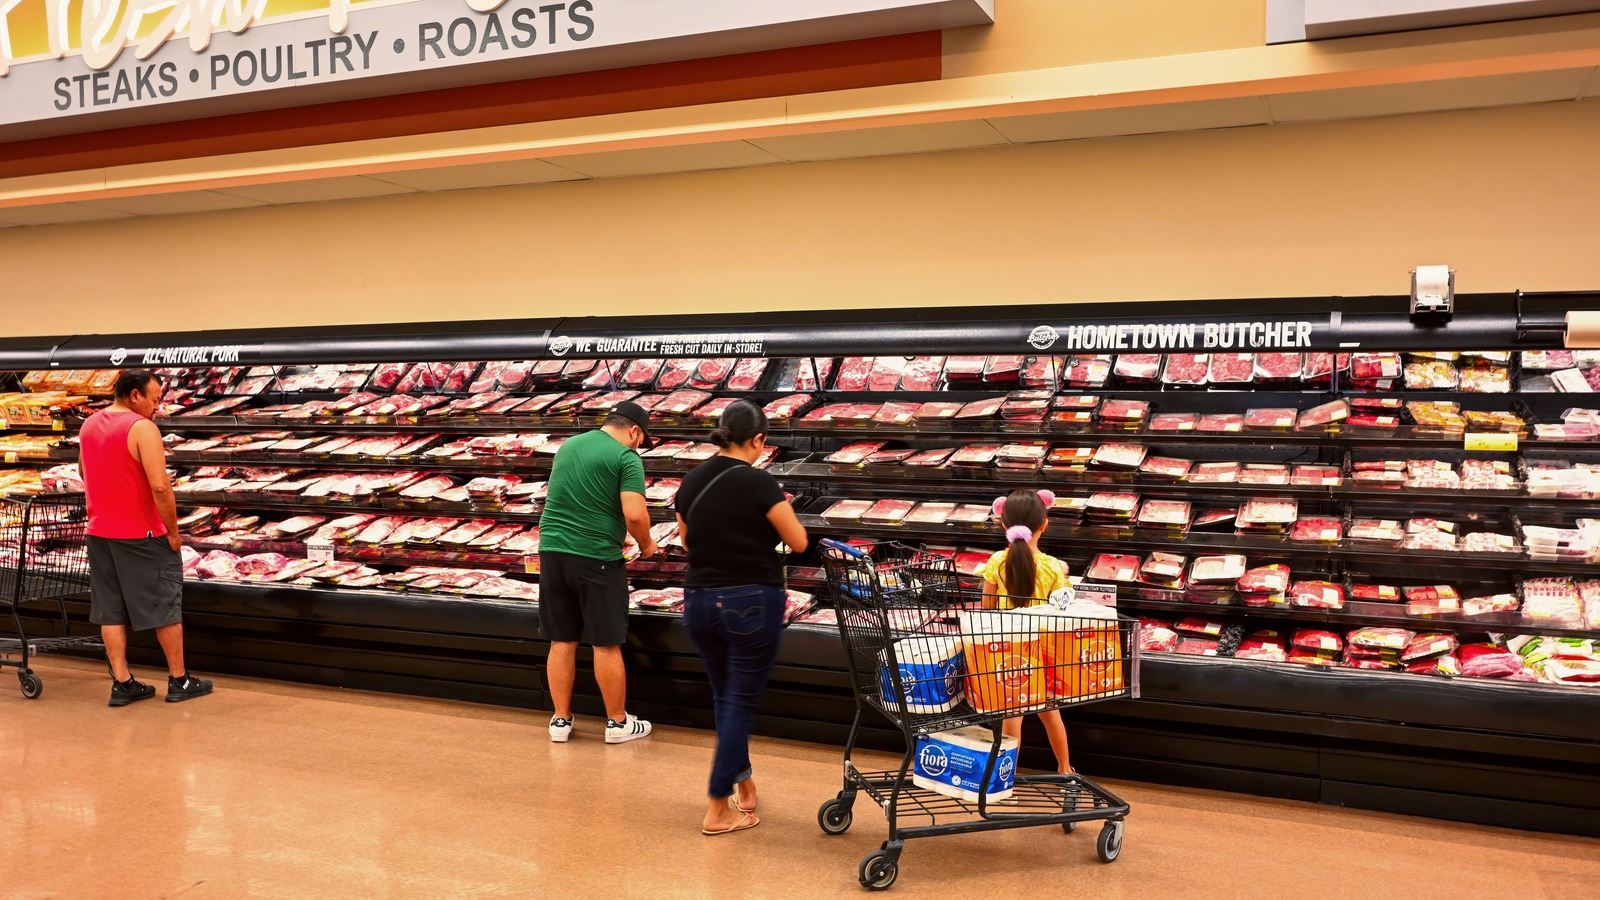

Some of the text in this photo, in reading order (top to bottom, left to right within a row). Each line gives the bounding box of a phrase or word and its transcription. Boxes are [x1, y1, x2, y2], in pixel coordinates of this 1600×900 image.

[53, 61, 178, 111] STEAKS
[210, 30, 379, 90] POULTRY
[418, 0, 595, 61] ROASTS
[1067, 324, 1195, 349] HOMETOWN
[1203, 321, 1313, 348] BUTCHER
[142, 346, 209, 364] ALL-NATURAL
[211, 345, 243, 363] PORK
[576, 338, 658, 352] WE GUARANTEE
[660, 343, 763, 355] FRESH CUT DAILY IN-STORE!
[919, 748, 948, 768] fiora
